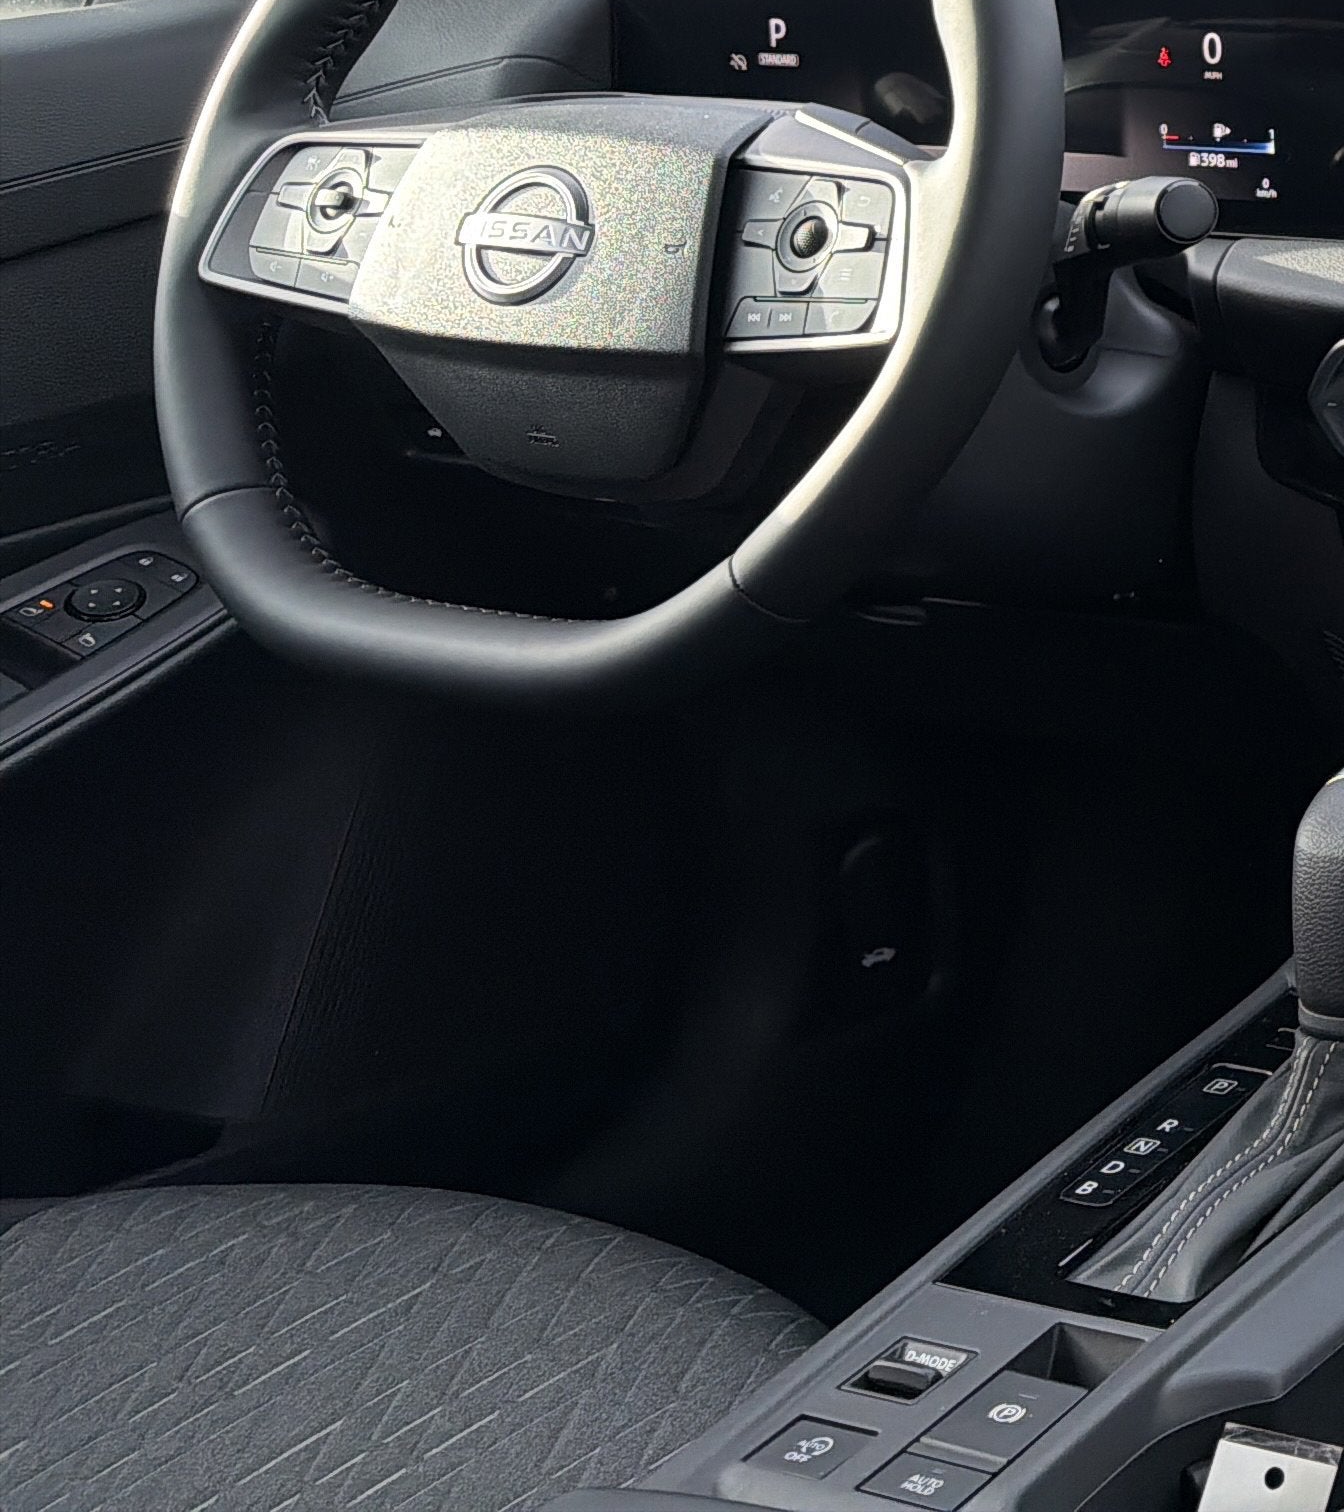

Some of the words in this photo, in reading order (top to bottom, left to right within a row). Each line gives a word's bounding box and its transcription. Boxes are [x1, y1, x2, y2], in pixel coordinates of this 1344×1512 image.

[768, 17, 787, 48] P
[1202, 32, 1222, 65] 0
[1200, 154, 1225, 167] 398
[1226, 158, 1238, 168] mi
[464, 214, 591, 252] ISSAN
[1156, 1118, 1179, 1132] R
[1100, 1160, 1125, 1174] D
[1075, 1181, 1099, 1195] B
[905, 1350, 957, 1371] D-MODE
[784, 1451, 809, 1463] OFF
[910, 1473, 944, 1489] AUTO
[901, 1482, 935, 1496] HOLD
